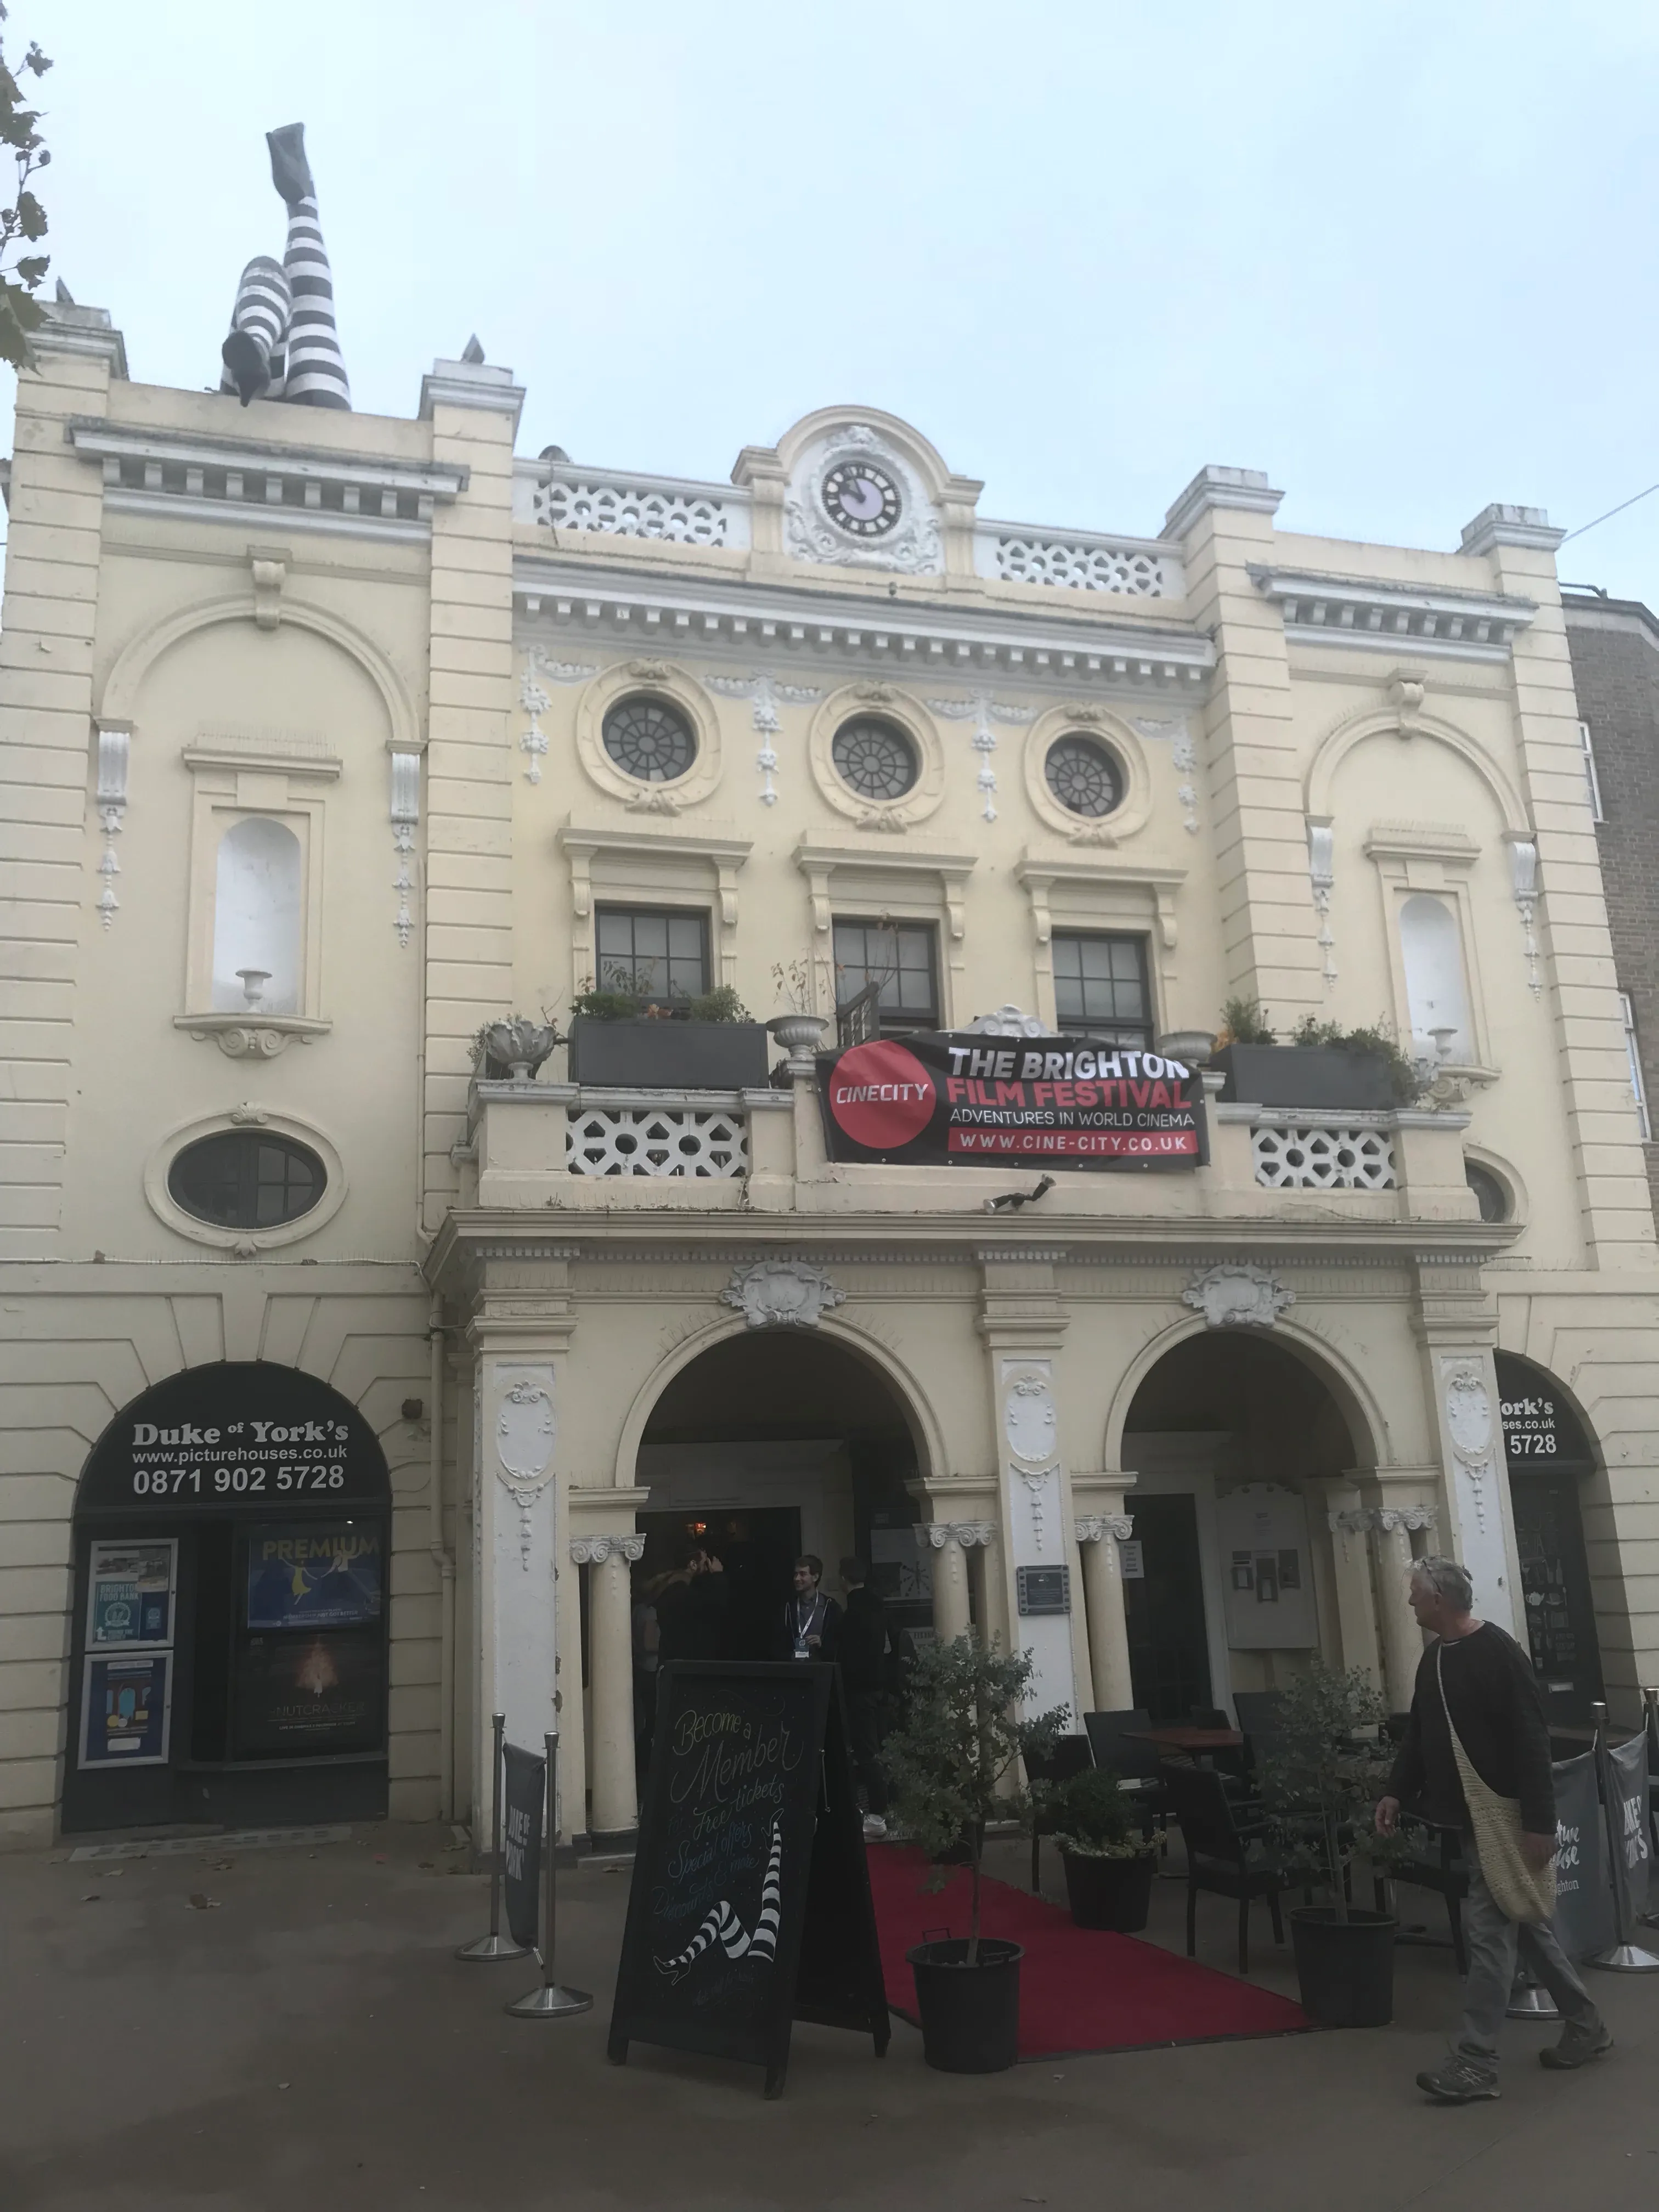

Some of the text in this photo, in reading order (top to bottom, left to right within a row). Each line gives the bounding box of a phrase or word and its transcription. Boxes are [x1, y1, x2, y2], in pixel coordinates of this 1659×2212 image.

[949, 1047, 1189, 1079] THE BRIGHTON
[836, 1083, 929, 1104] CINECITY
[946, 1077, 1192, 1109] FILM FESTIVAL
[949, 1108, 1195, 1127] ADVENTURES IN WORLD CINEMA
[960, 1133, 1187, 1150] WWW.CINE-CITY.CO.UK
[1499, 1397, 1554, 1415] ork's
[132, 1420, 349, 1446] Duke of York's
[1511, 1434, 1557, 1454] 5728
[132, 1445, 348, 1465] www.picturehouses.co.uk
[133, 1465, 344, 1494] 0871 902 5728
[263, 1536, 380, 1560] PREMIUM
[673, 1709, 752, 1756] Become a
[670, 1721, 804, 1803] Member
[692, 1805, 733, 1841] Free
[730, 1773, 785, 1812] tickets
[668, 1821, 753, 1884] Special offers
[1556, 1880, 1580, 1896] ghton
